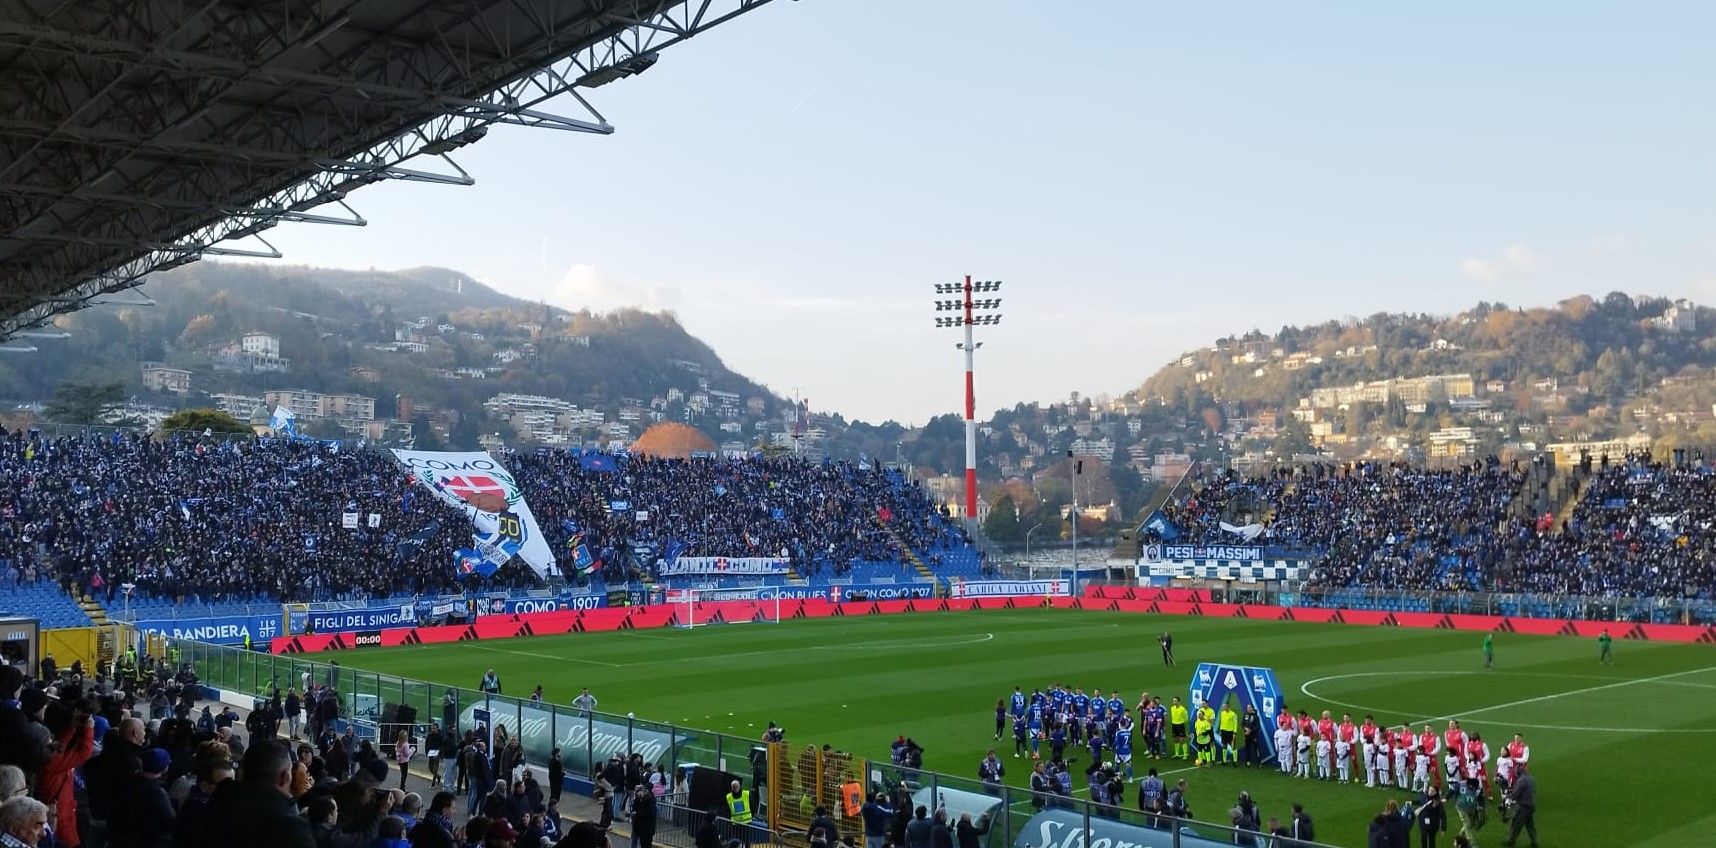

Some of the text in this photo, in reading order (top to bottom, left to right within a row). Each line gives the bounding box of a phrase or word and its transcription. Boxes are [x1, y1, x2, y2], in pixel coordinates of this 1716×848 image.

[407, 457, 494, 471] COMO
[1166, 547, 1260, 560] PESI MASSIMI
[730, 558, 772, 572] COMO
[879, 587, 909, 598] COMO
[515, 600, 556, 614] COMO
[572, 597, 600, 611] 1907
[315, 617, 343, 629] FIGLI
[347, 615, 366, 627] DEL
[173, 624, 250, 640] BANDIERA
[356, 635, 381, 645] 00:00
